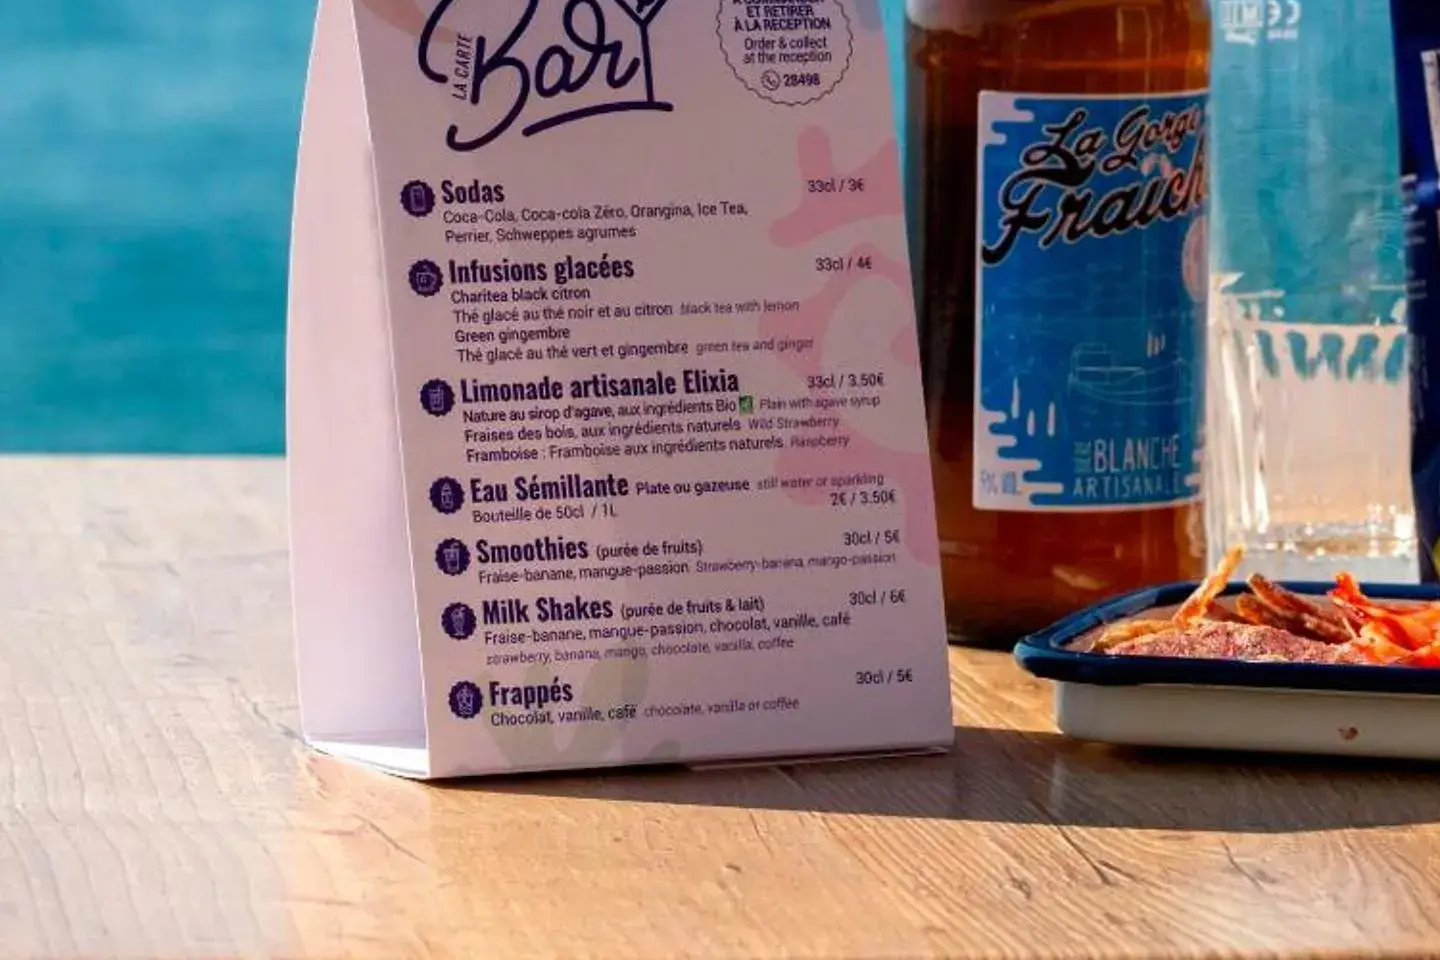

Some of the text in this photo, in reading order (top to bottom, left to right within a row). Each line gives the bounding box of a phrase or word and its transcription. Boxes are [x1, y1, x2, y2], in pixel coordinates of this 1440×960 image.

[746, 5, 814, 18] ET RETIRER
[745, 19, 761, 31] LA
[744, 36, 826, 50] Order & collect
[452, 32, 473, 100] LA CARTE
[743, 51, 832, 66] at the reception
[1020, 106, 1106, 170] La
[441, 179, 505, 204] Sodas
[808, 178, 865, 193] 33cl 3€
[521, 207, 590, 222] Coca-cola
[697, 202, 717, 216] Ice
[497, 227, 573, 245] Schweppes
[577, 224, 637, 243] agrumes
[449, 253, 634, 285] Infusions glacées
[815, 256, 872, 272] 33cl 4€
[451, 286, 590, 304] Charitea black citron
[453, 309, 478, 324] Thé
[482, 307, 519, 326] glacé
[523, 309, 540, 321] au
[543, 307, 565, 321] thé
[568, 305, 594, 320] noir
[598, 304, 611, 318] et
[614, 305, 631, 318] au
[635, 301, 673, 316] citron
[454, 325, 571, 344] Green gingembre
[456, 348, 483, 363] Thé
[486, 346, 524, 366] glacé
[526, 348, 544, 360] au
[547, 345, 569, 360] thé
[571, 344, 598, 358] vert
[601, 343, 614, 357] et
[618, 340, 688, 360] gingembre
[460, 368, 739, 403] Limonade artisanale Elixia
[807, 372, 884, 389] 33cl 3.50€
[463, 409, 507, 424] Nature
[510, 409, 525, 421] au
[528, 406, 560, 423] sirop
[618, 404, 640, 417] aux
[643, 400, 713, 417] ingrédients
[716, 399, 736, 412] Bio
[465, 428, 514, 443] Fraises
[518, 426, 542, 440] des
[582, 425, 605, 437] aux
[609, 420, 683, 439] ingrédients
[687, 417, 741, 433] naturels
[466, 447, 538, 463] Framboise
[550, 443, 620, 459] Framboise
[625, 443, 648, 456] aux
[652, 438, 727, 458] ingrédients
[729, 436, 784, 452] naturels
[1094, 435, 1181, 473] BLANCHE
[470, 477, 508, 503] Eau
[514, 472, 629, 502] Sémillante
[635, 479, 670, 495] Plate
[673, 482, 691, 494] ou
[694, 479, 750, 497] gazeuse
[829, 489, 896, 506] 2€ 3.50€
[473, 507, 532, 524] Bouteille
[535, 505, 551, 520] de
[556, 504, 584, 520] 50cl
[844, 529, 900, 547] 30cl 5€
[476, 537, 703, 564] Smoothies (purée de fruits)
[579, 560, 689, 582] mangue-passion
[850, 591, 877, 606] 30cl
[482, 595, 765, 625] Milk Shakes (purée de fruits & lait)
[822, 611, 851, 627] café
[856, 668, 914, 686] 30cl 5€
[489, 676, 574, 709] Frappés
[608, 704, 637, 720] café
